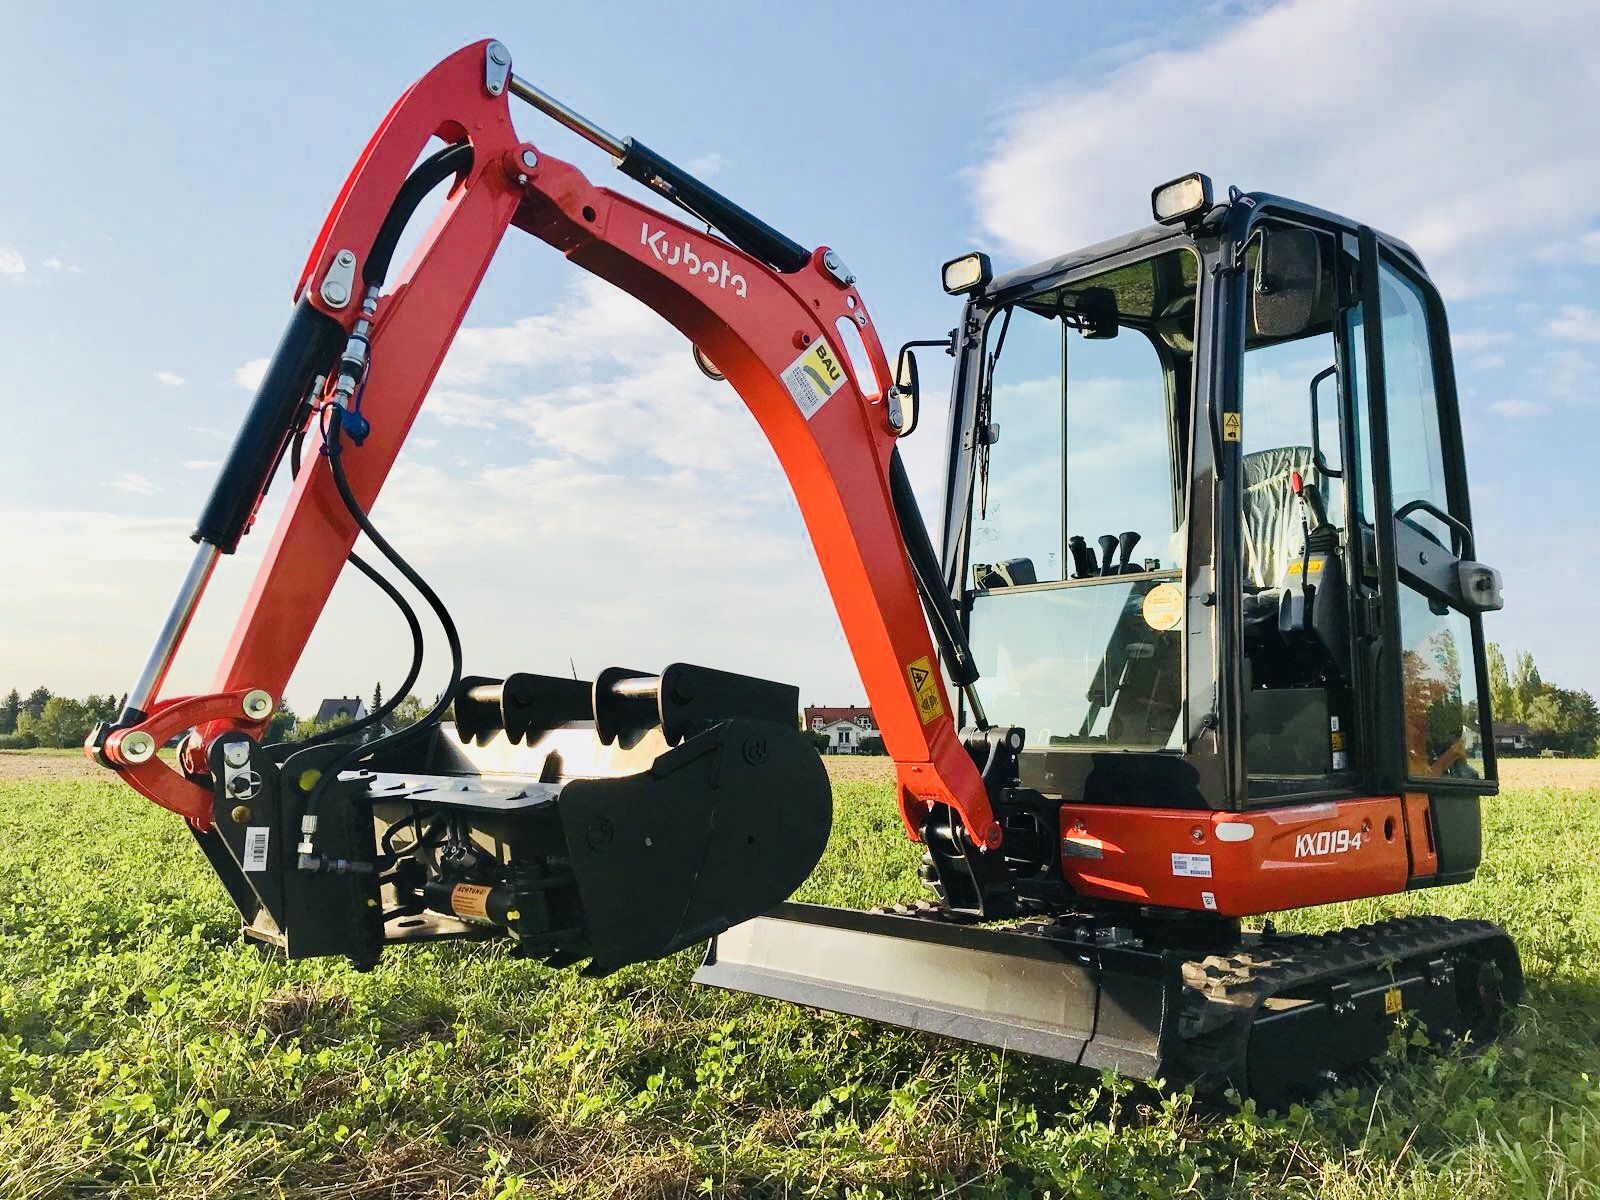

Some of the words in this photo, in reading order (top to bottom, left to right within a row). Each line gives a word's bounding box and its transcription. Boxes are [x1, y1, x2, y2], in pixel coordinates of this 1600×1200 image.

[641, 222, 747, 298] Kubota
[816, 344, 840, 380] BAU
[1295, 829, 1361, 857] KX019-4
